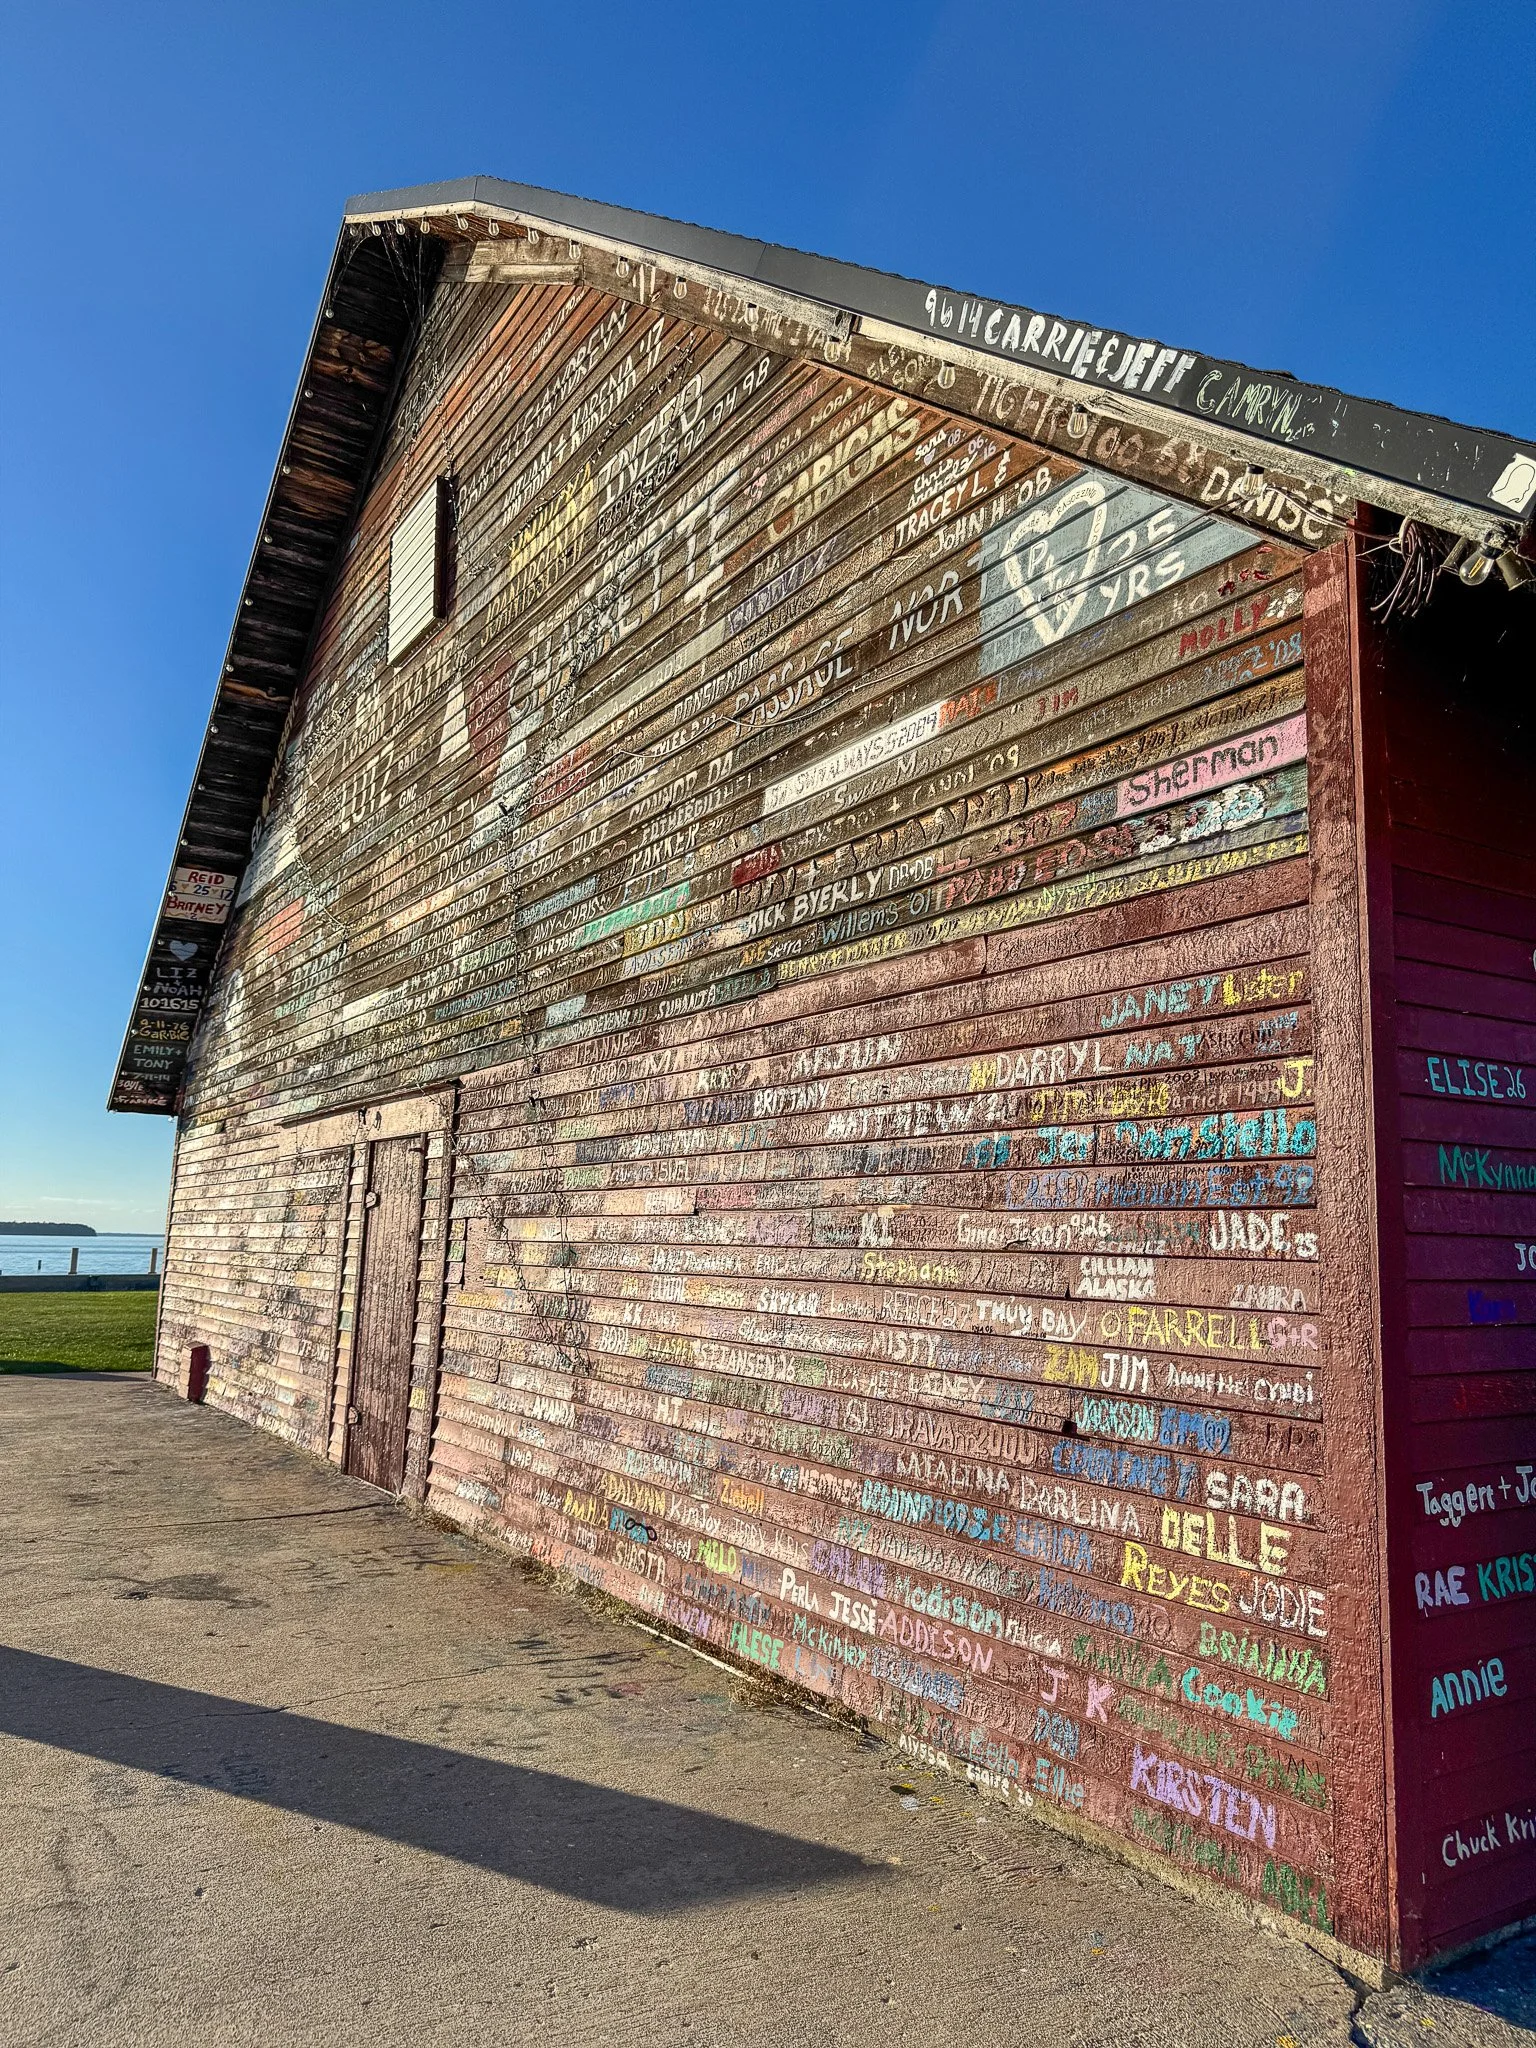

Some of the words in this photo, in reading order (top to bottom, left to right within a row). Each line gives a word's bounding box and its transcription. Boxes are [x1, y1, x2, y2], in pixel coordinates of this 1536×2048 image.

[896, 478, 969, 548] TRACEY
[1100, 550, 1186, 618] YRS
[1178, 593, 1271, 658] MOLLY
[1127, 734, 1280, 806] Sherman
[188, 871, 225, 885] REID
[193, 884, 210, 896] 25
[219, 888, 234, 901] 17
[747, 902, 787, 937] RICK
[791, 866, 885, 923] BYERLY
[165, 896, 227, 915] BRITNEY
[821, 902, 899, 944] Willems
[156, 967, 197, 979] LIZ
[1100, 975, 1220, 1030] JANET
[133, 1044, 174, 1055] EMILY
[133, 1058, 173, 1069] TONY
[996, 1040, 1113, 1088] DARRYL
[753, 1081, 829, 1118] BRITTANY
[1426, 1056, 1505, 1099] ELISE
[1506, 1066, 1526, 1100] 26
[1209, 1209, 1291, 1252] JADE
[1076, 1276, 1157, 1300] ALASKA
[1100, 1352, 1150, 1394] JIM
[1205, 1469, 1307, 1522] SARA
[1416, 1481, 1496, 1527] Taggert
[1414, 1564, 1470, 1610] RAE
[1477, 1552, 1536, 1602] KRIS
[1237, 1575, 1329, 1638] JODIE
[1431, 1656, 1508, 1718] Annie
[1130, 1743, 1277, 1850] KIRSTEN
[1441, 1819, 1501, 1868] Chuck
